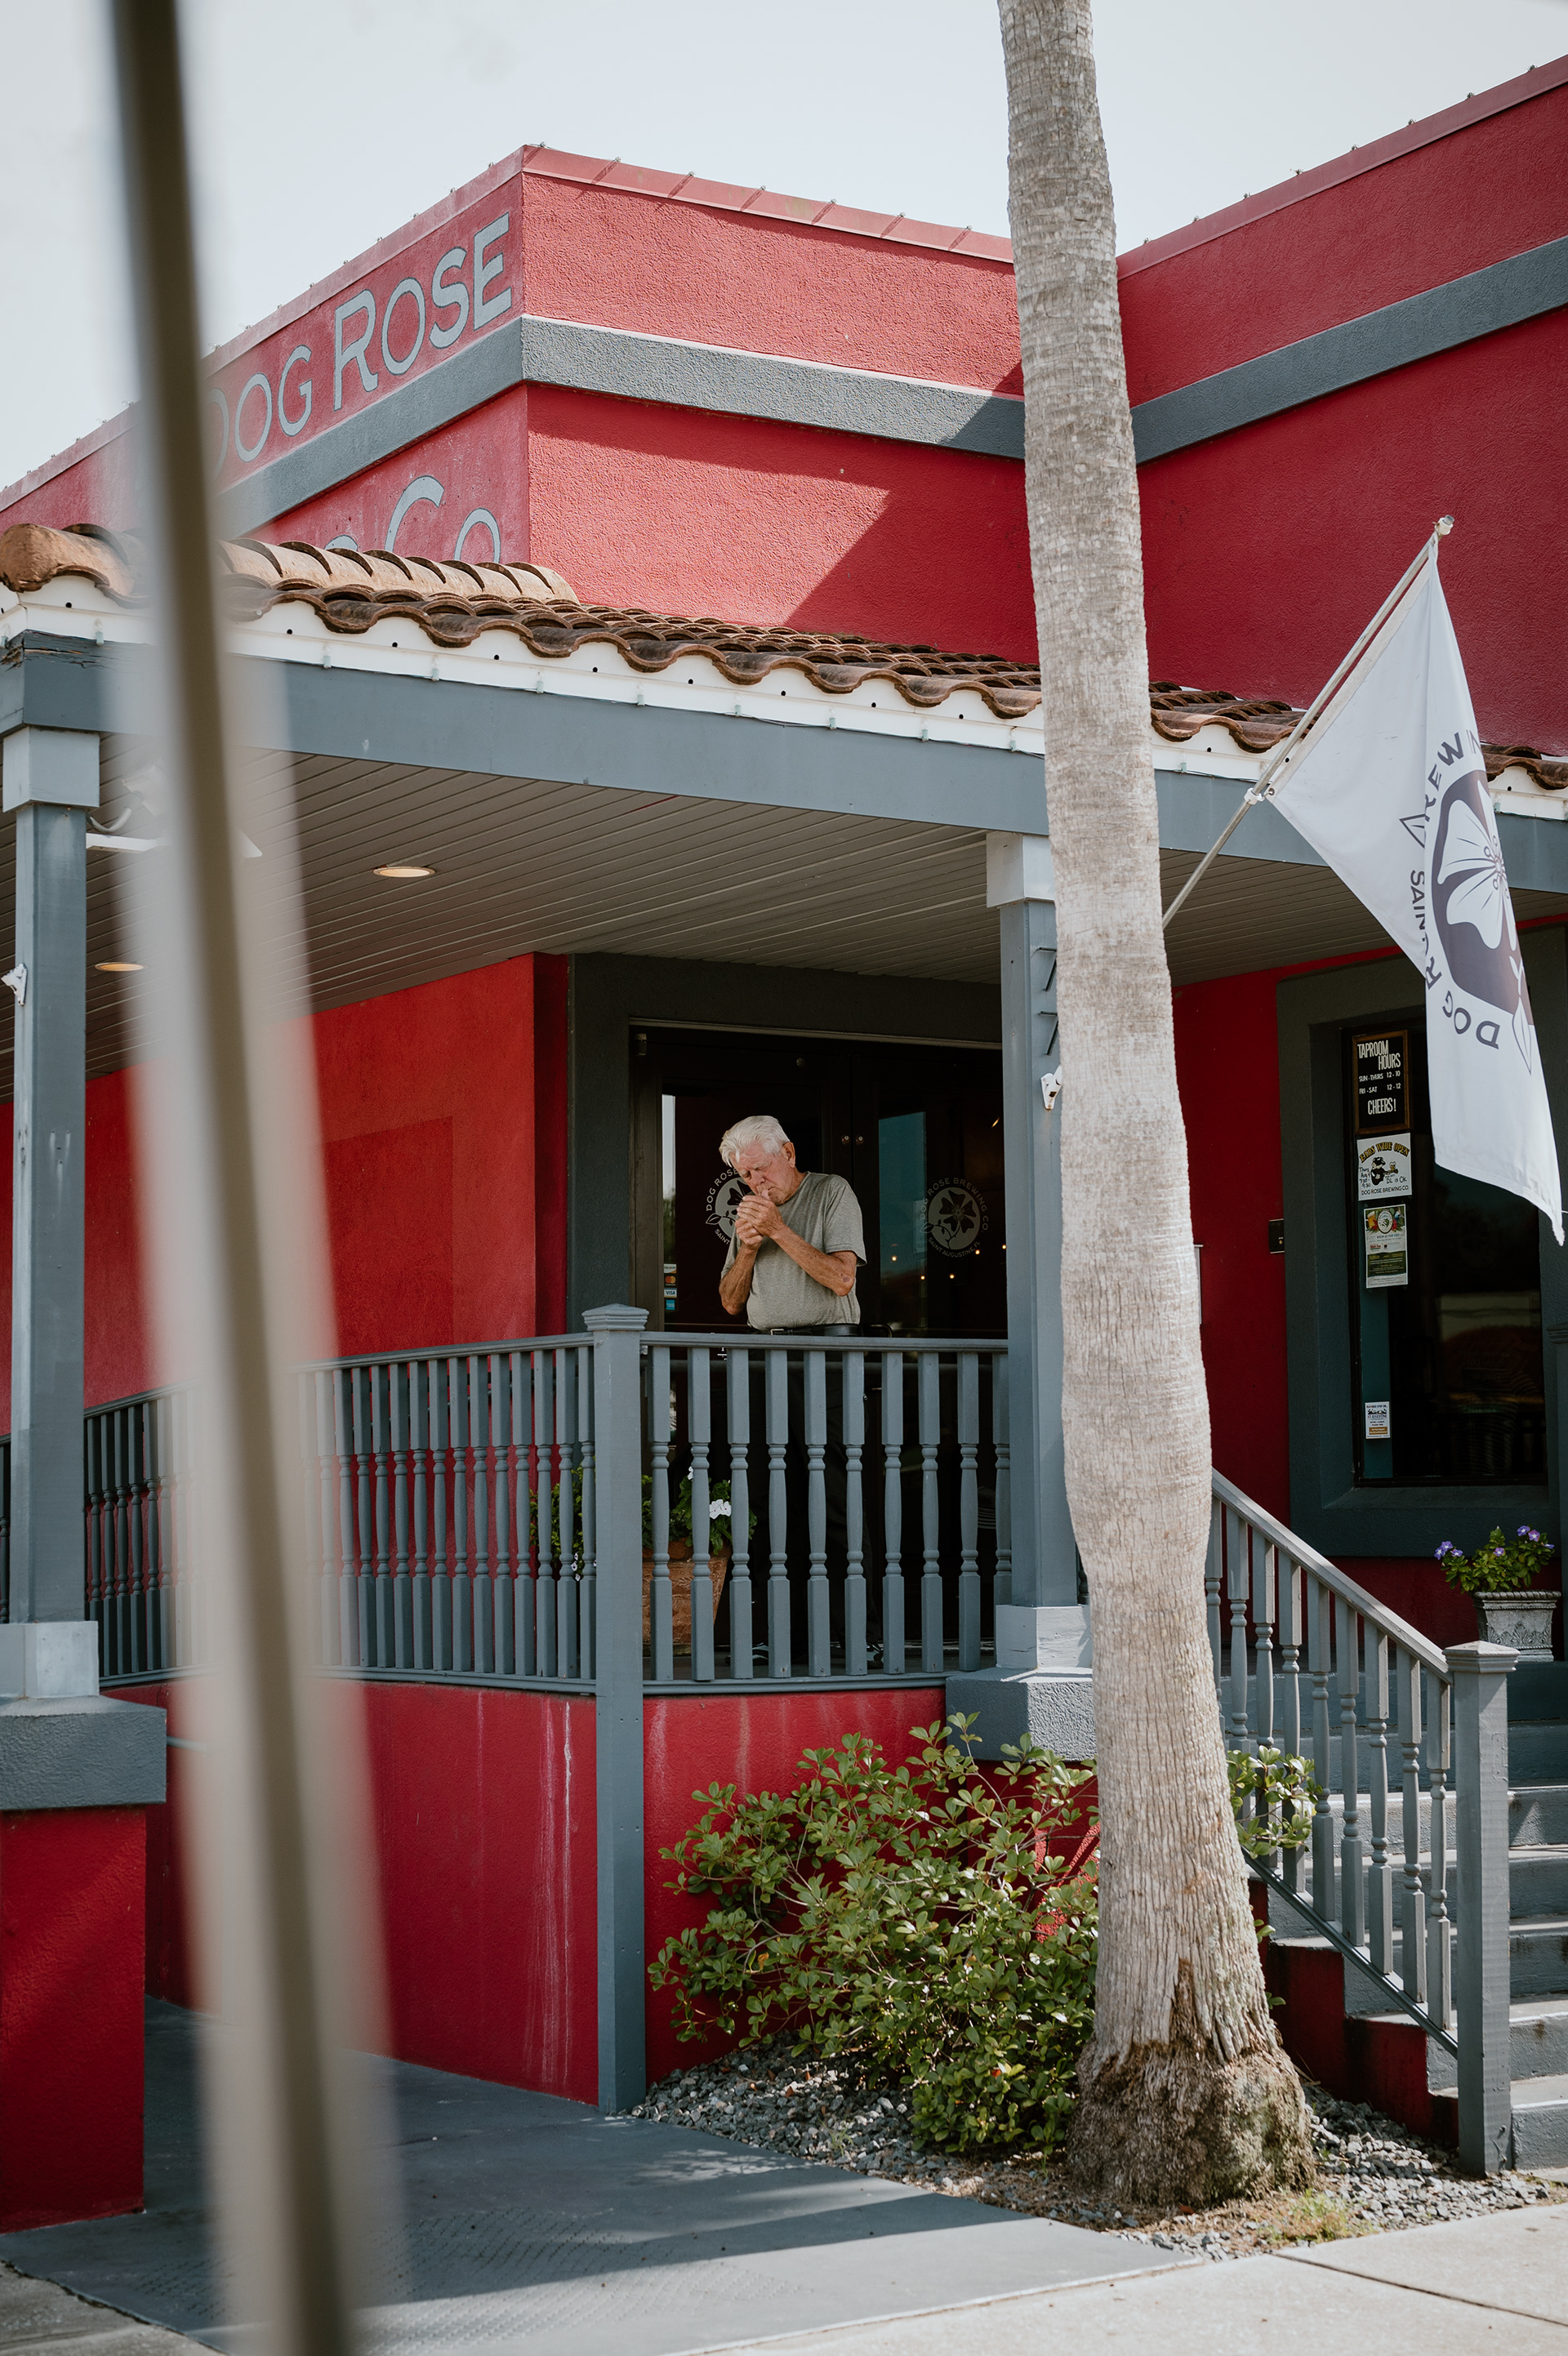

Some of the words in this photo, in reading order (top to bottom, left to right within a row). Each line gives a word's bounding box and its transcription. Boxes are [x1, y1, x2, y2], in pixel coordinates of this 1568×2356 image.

[333, 212, 512, 411] ROSE
[1410, 870, 1425, 942] SAIN
[1442, 991, 1500, 1049] DOG
[1357, 1040, 1388, 1058] TAPROOM
[1378, 1053, 1401, 1070] HOURS
[1368, 1097, 1396, 1115] CHEERS!
[1360, 1146, 1375, 1163] EARS
[1376, 1142, 1393, 1152] WIDE
[1394, 1143, 1410, 1157] OPEN
[706, 1187, 716, 1211] DOG
[920, 1197, 929, 1219] DOG
[927, 1178, 950, 1196] ROSE
[954, 1178, 987, 1211] BREWING
[715, 1229, 730, 1245] SAINT
[928, 1237, 943, 1253] SAINT
